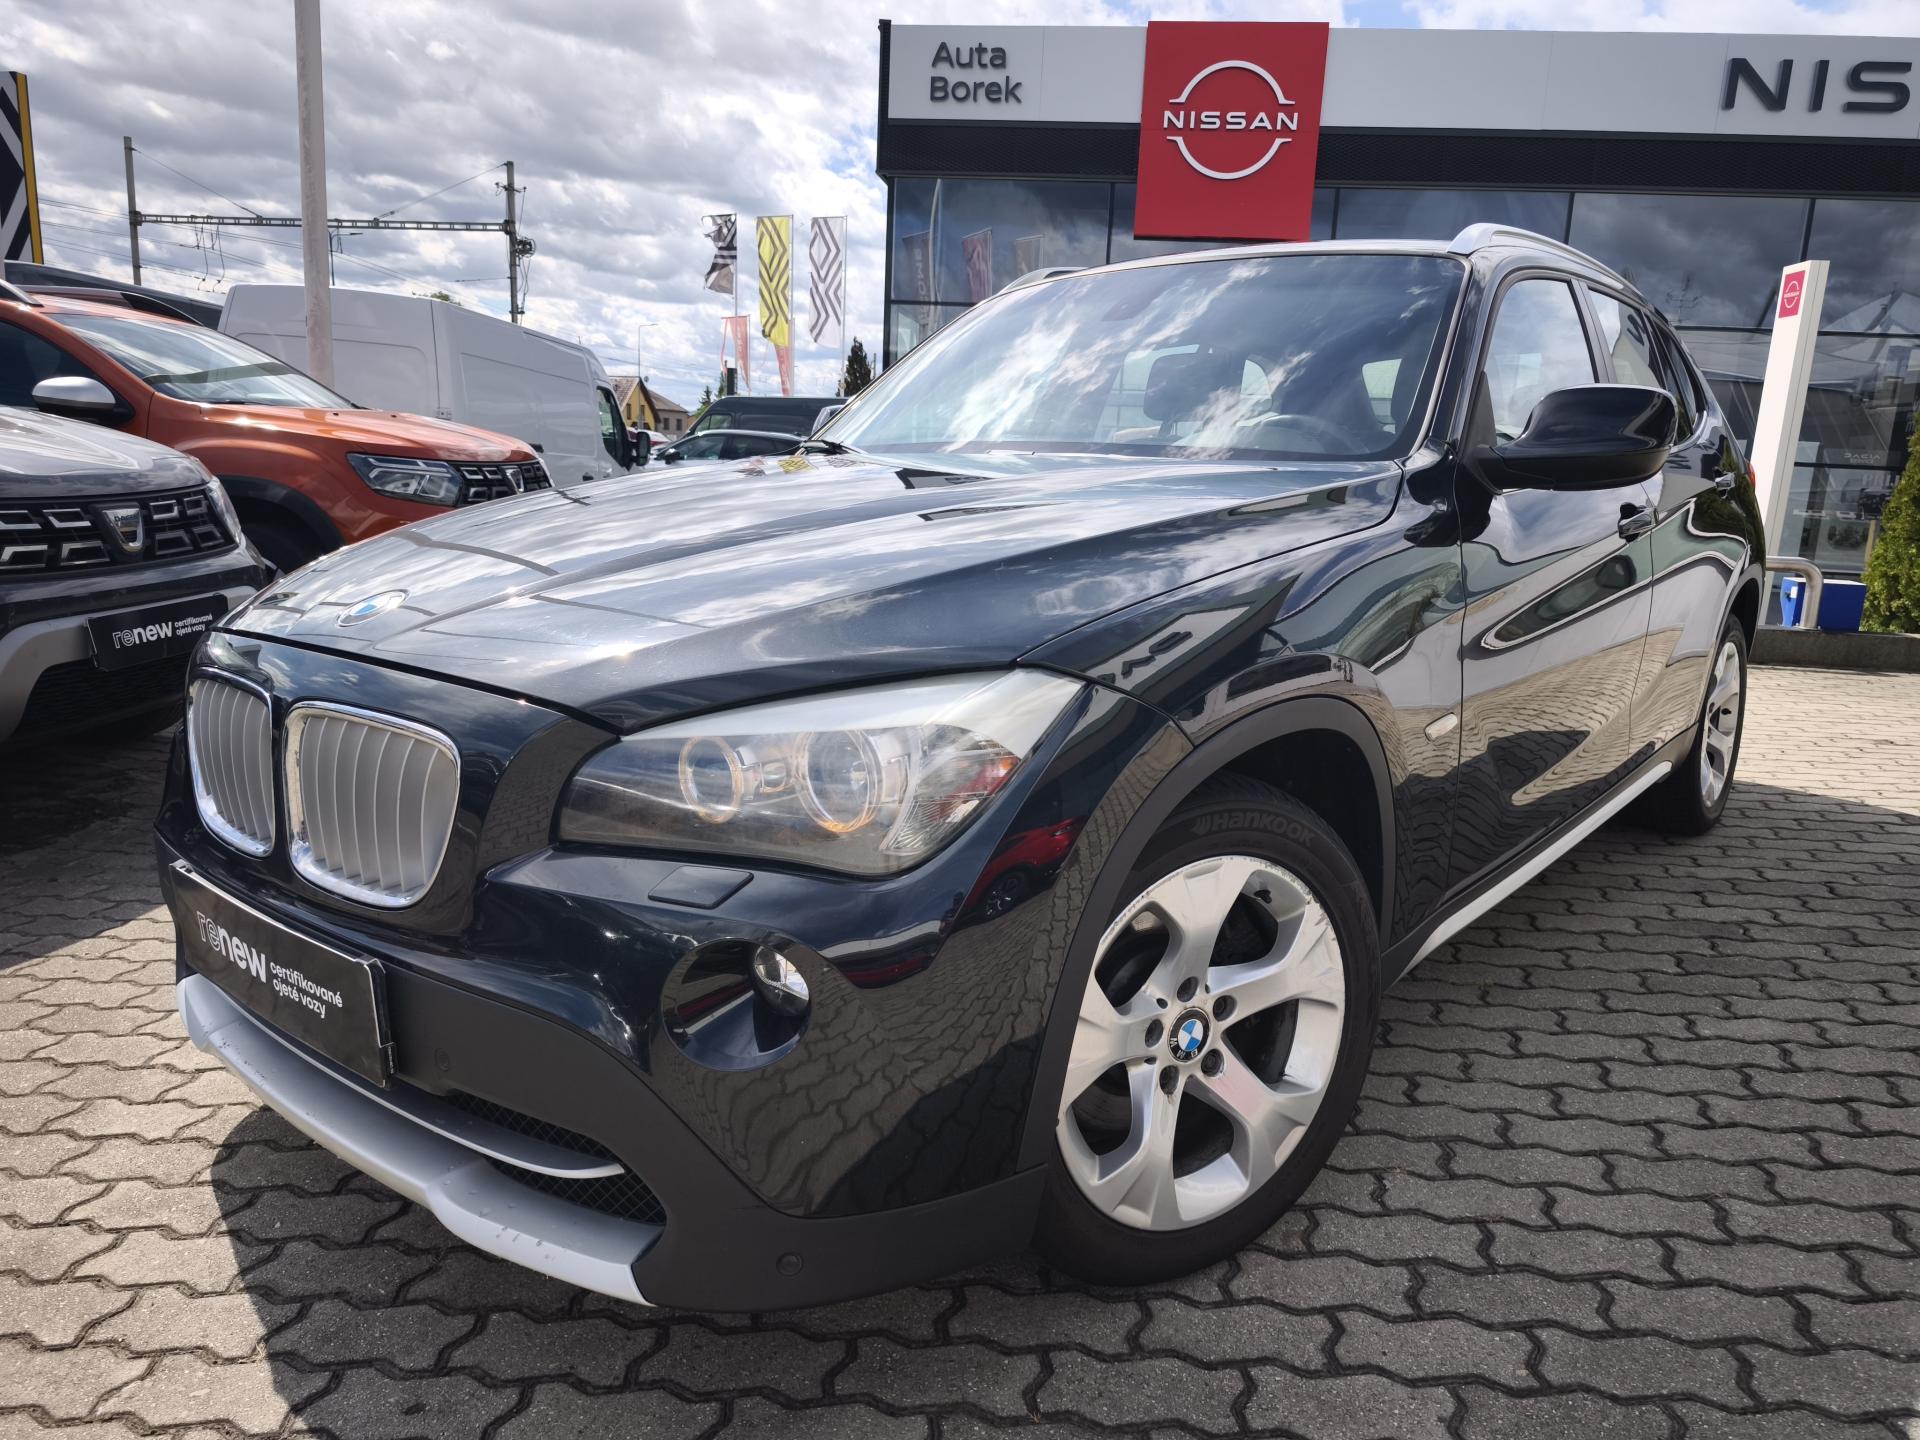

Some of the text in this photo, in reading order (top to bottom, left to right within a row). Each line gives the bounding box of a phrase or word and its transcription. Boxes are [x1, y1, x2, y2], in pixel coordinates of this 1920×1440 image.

[931, 41, 1007, 69] Auta
[930, 75, 1022, 103] Borek
[1721, 57, 1913, 113] NIS
[1163, 110, 1299, 131] NISSAN
[112, 621, 173, 649] renew
[192, 623, 206, 632] vozy
[196, 910, 267, 984] renew
[270, 961, 343, 1008] certifikované
[273, 979, 326, 1019] ojeté vozy
